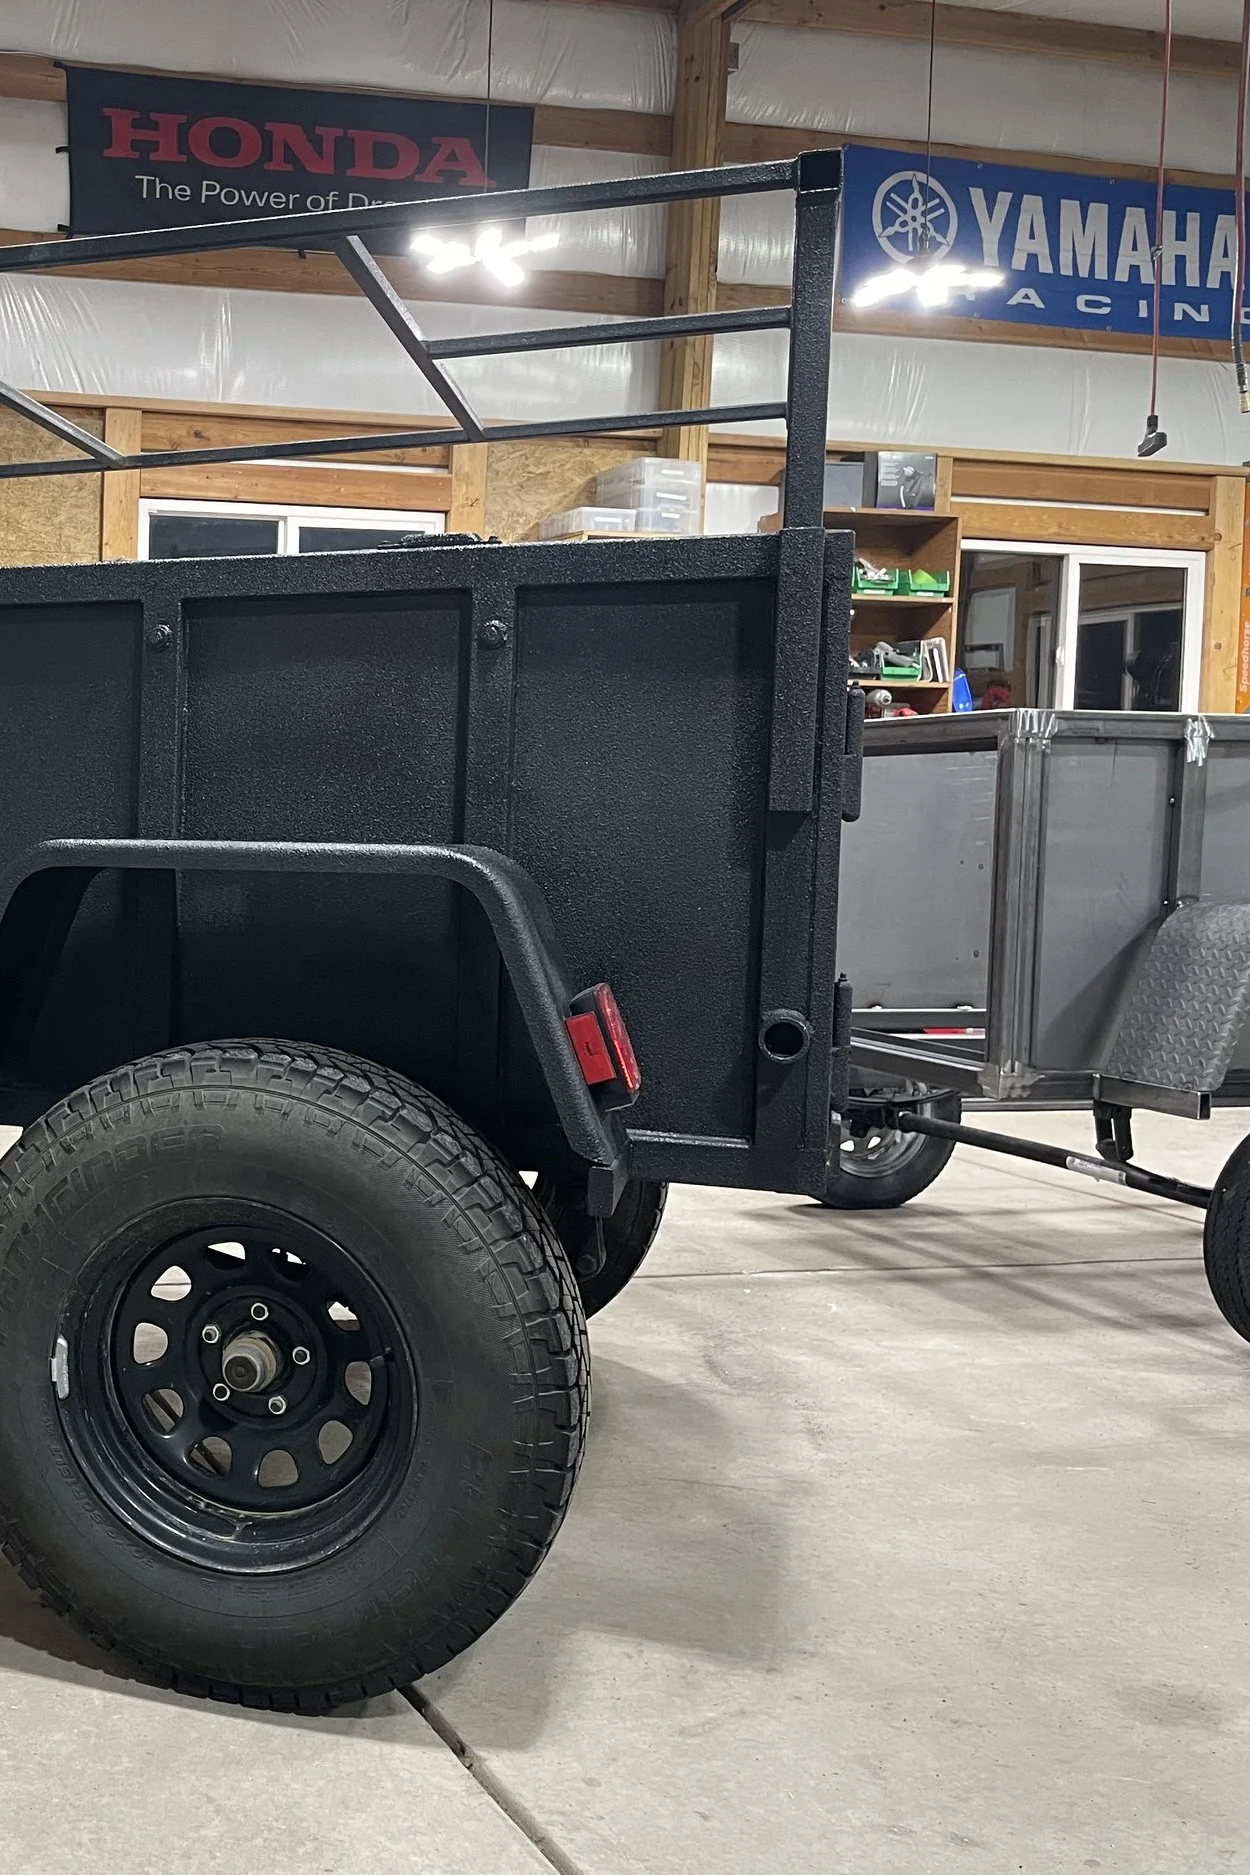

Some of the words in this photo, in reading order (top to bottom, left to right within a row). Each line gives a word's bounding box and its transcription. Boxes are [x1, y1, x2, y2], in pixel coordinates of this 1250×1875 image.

[102, 107, 496, 188] HONDA
[135, 174, 192, 203] The
[201, 181, 300, 211] Power
[306, 190, 339, 211] of
[969, 187, 1242, 289] YAMAHA
[961, 286, 1250, 325] ACIN
